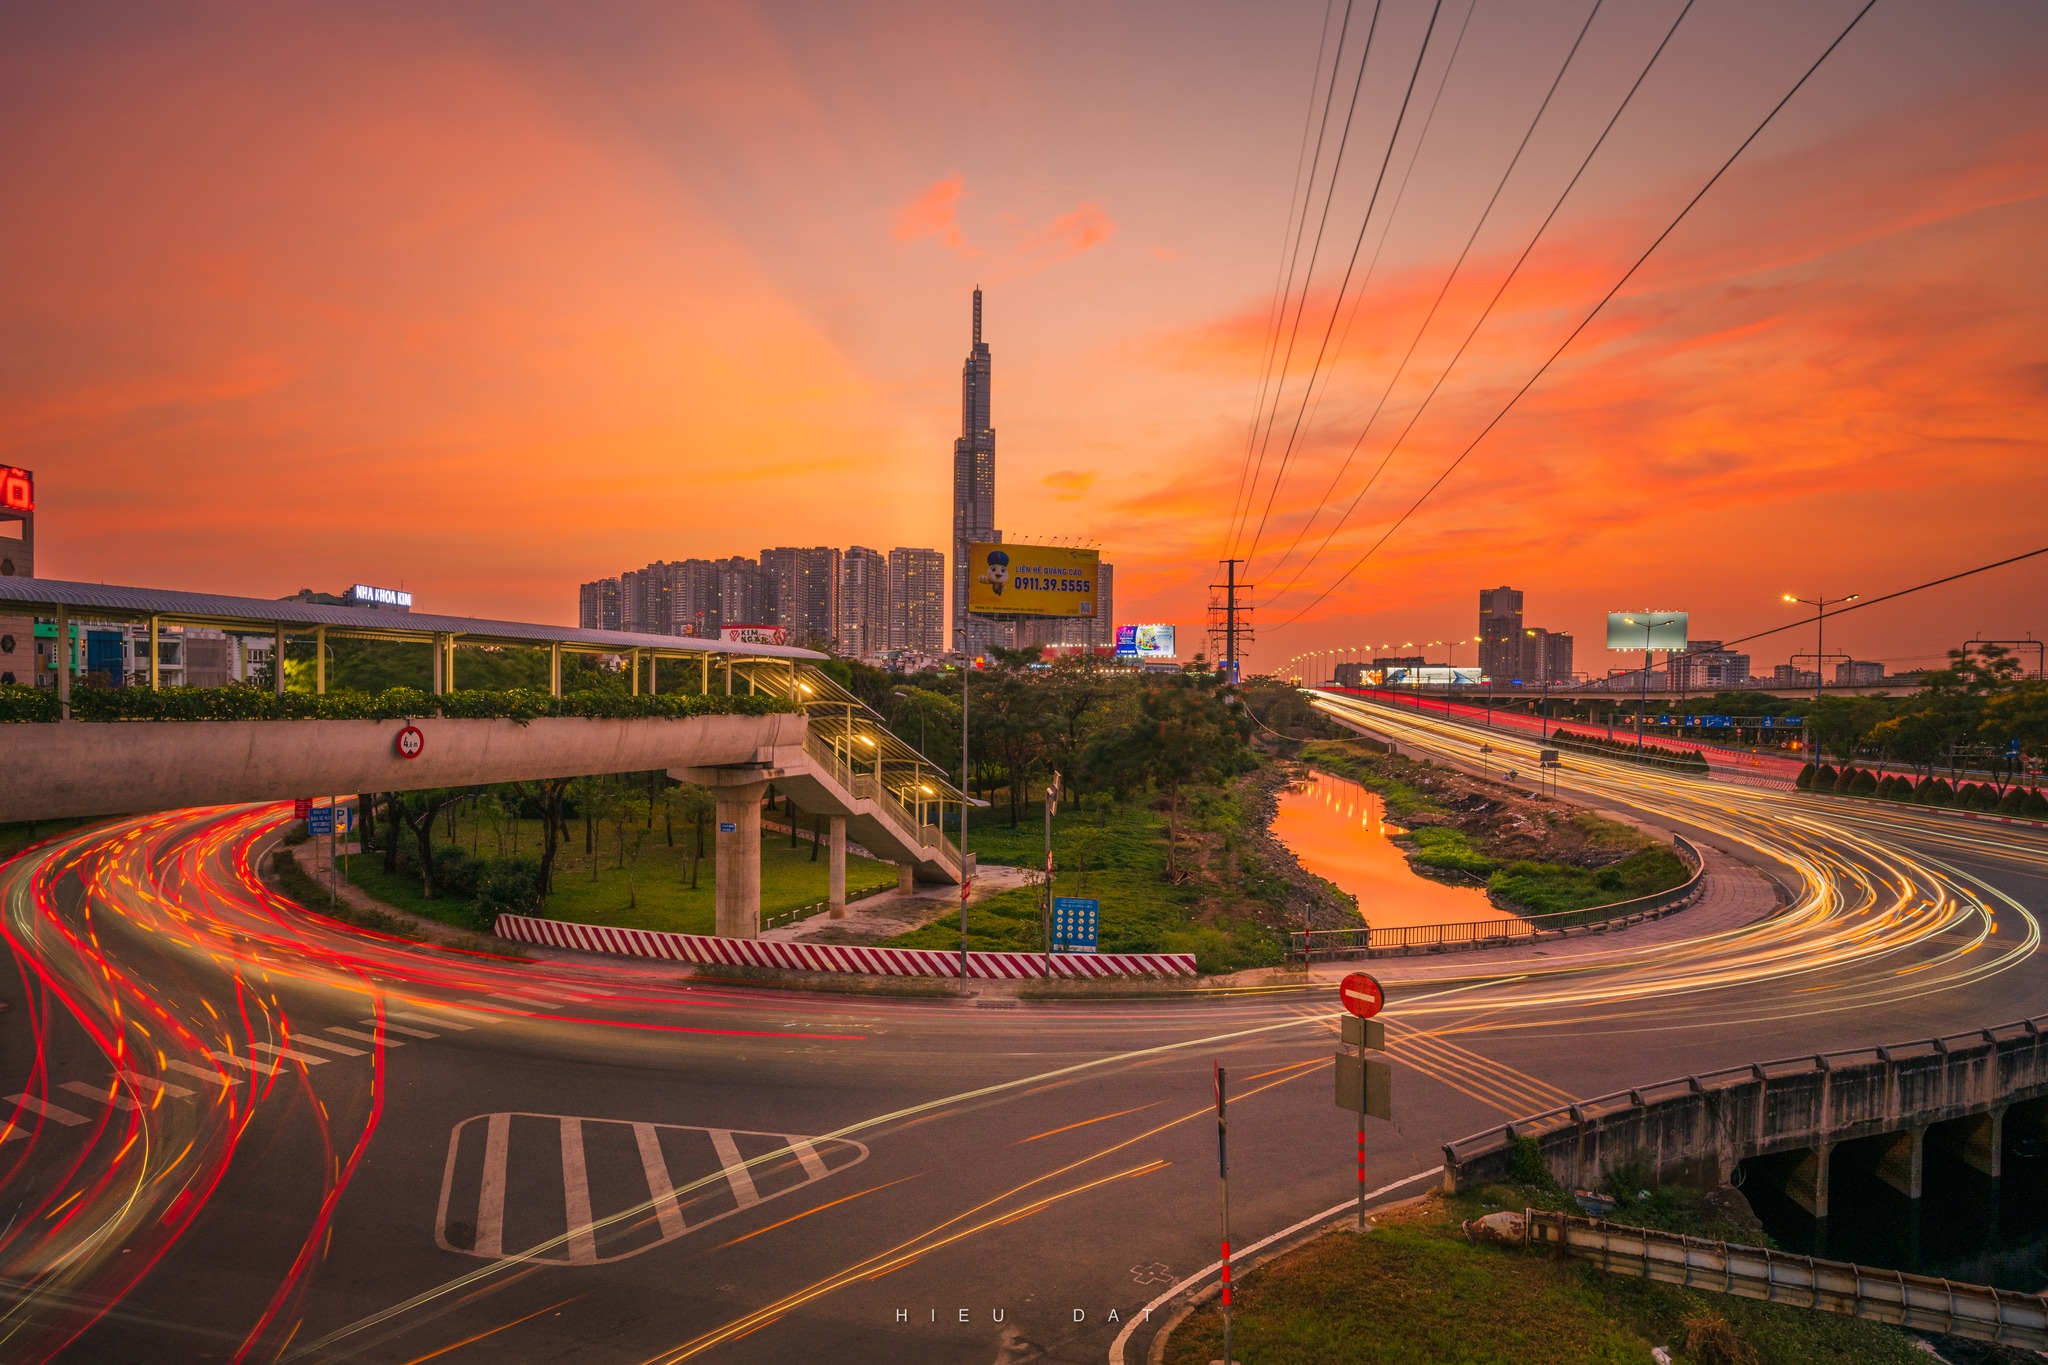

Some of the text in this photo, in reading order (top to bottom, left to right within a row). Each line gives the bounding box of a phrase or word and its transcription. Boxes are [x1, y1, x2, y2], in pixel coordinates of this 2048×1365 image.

[1015, 564, 1030, 573] LIÊN
[1044, 566, 1066, 575] QUẢNG
[1069, 568, 1082, 576] CÁO
[1014, 577, 1090, 592] 0911.39.5555
[356, 585, 412, 606] NHA KHOA KIM
[336, 809, 345, 820] P
